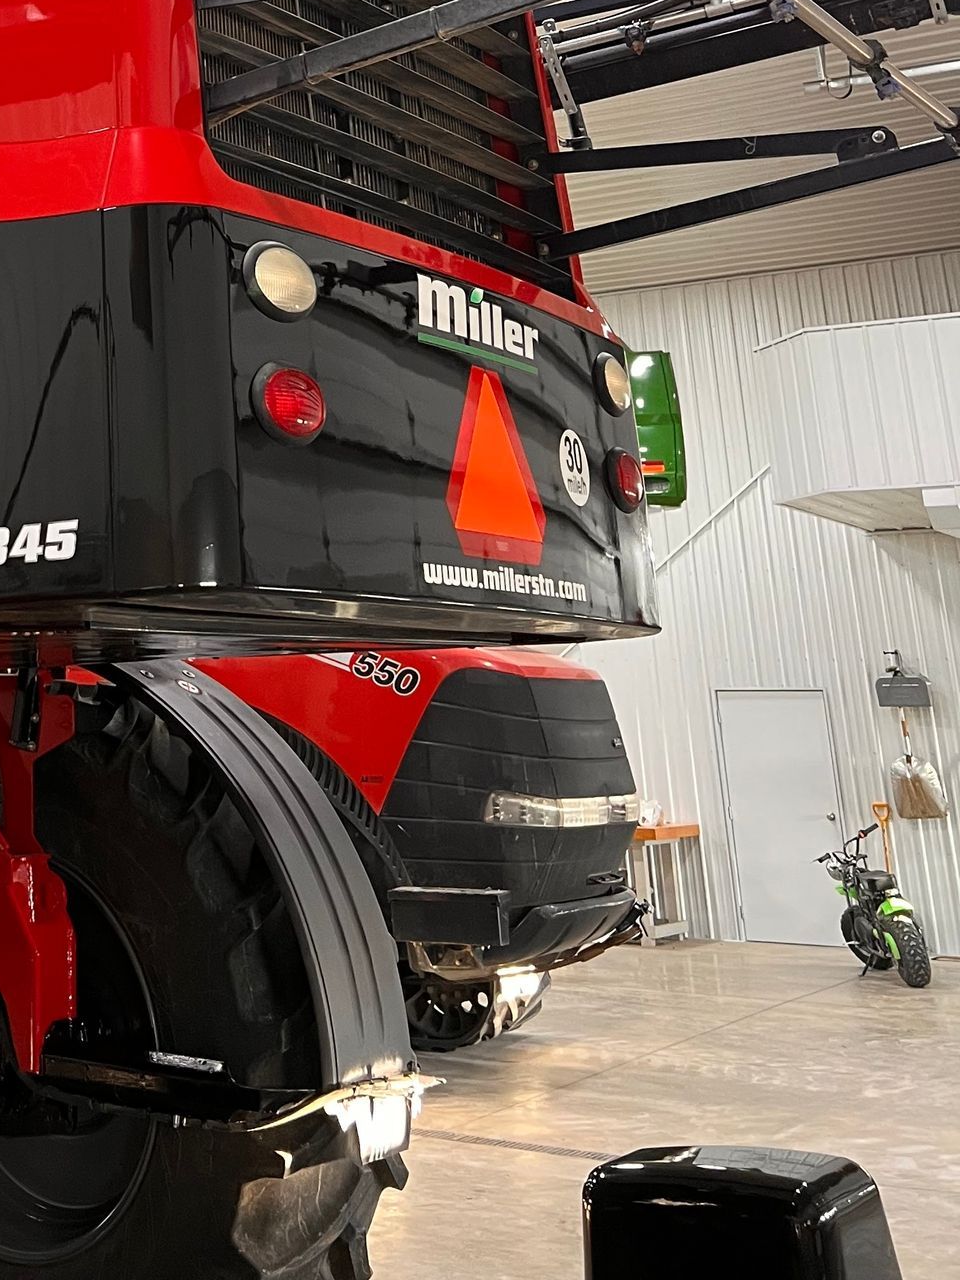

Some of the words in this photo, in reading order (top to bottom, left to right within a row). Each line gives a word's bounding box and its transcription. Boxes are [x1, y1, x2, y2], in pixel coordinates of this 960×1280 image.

[417, 273, 539, 360] miller
[564, 436, 583, 474] 30
[423, 563, 587, 602] www.millerstn.com
[352, 651, 421, 696] 550
